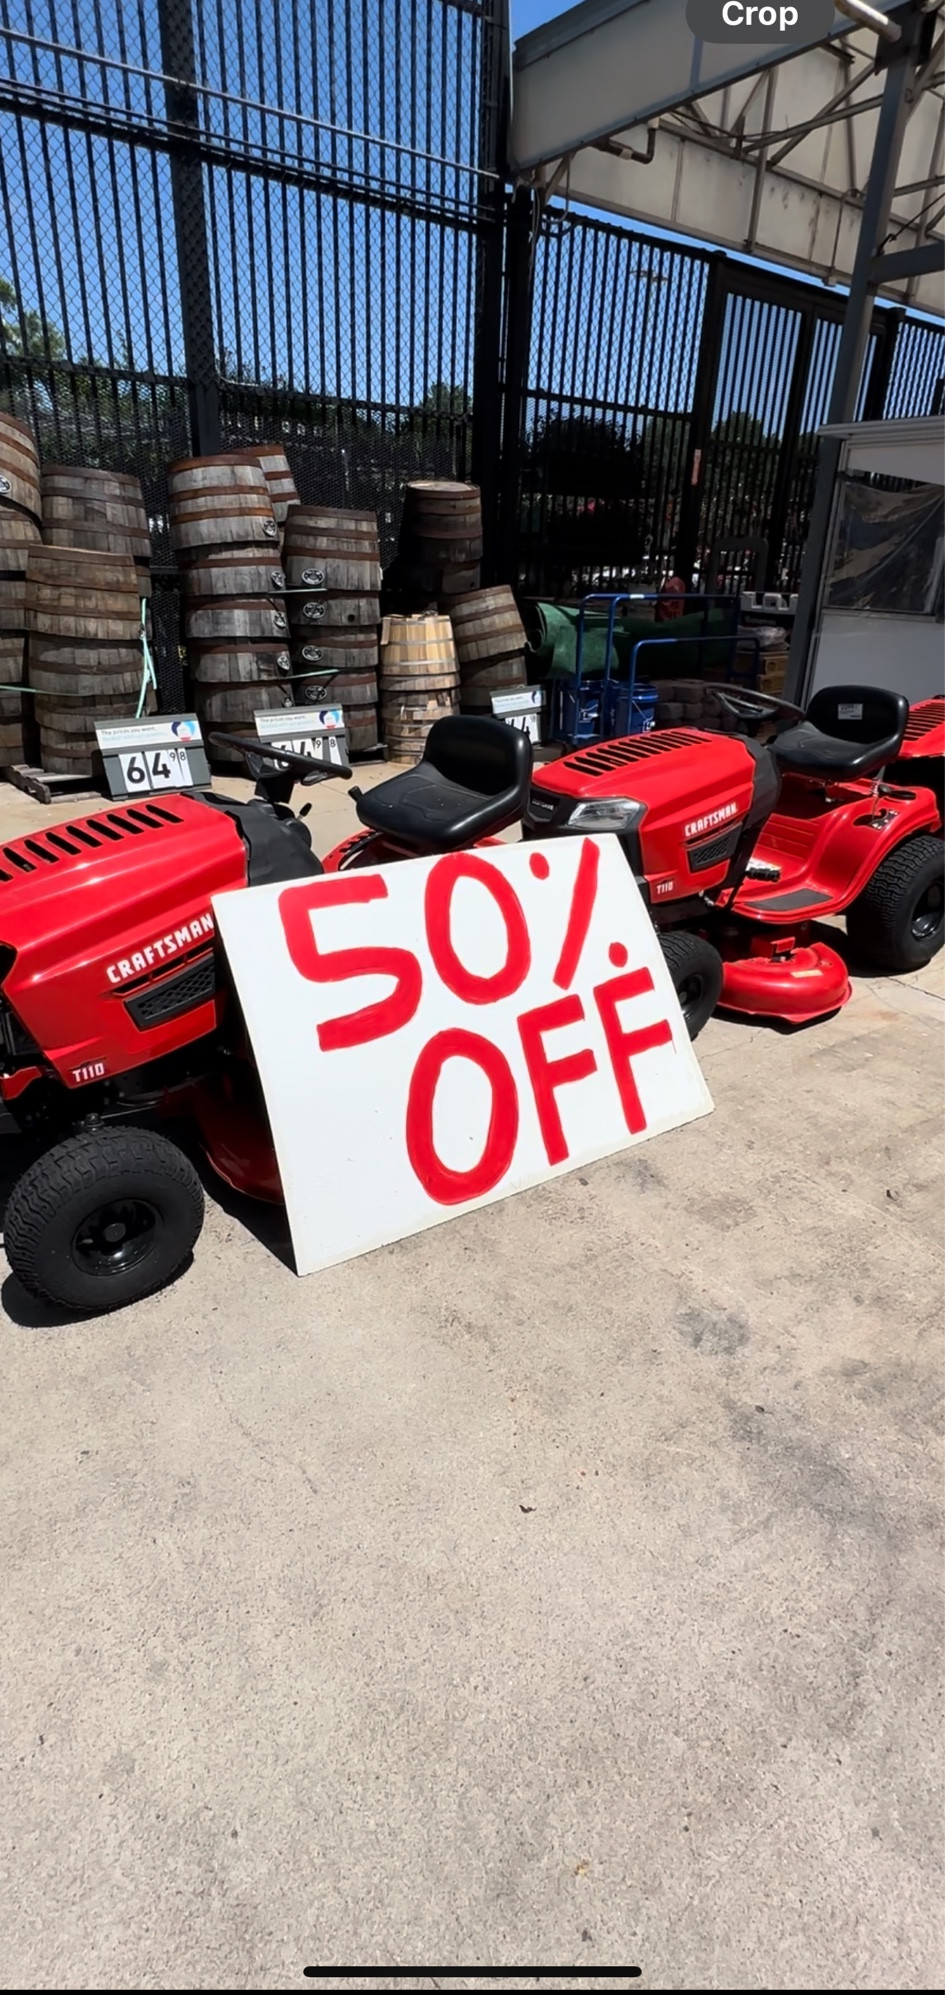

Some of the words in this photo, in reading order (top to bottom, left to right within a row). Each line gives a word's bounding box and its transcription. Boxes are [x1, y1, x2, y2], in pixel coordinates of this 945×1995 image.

[684, 802, 738, 837] CRAFTSMAN
[656, 881, 674, 894] T110
[106, 912, 214, 983] CRAFTSMAN
[278, 837, 628, 1052] 50%
[72, 1062, 105, 1082] T110
[406, 966, 674, 1206] OFF
